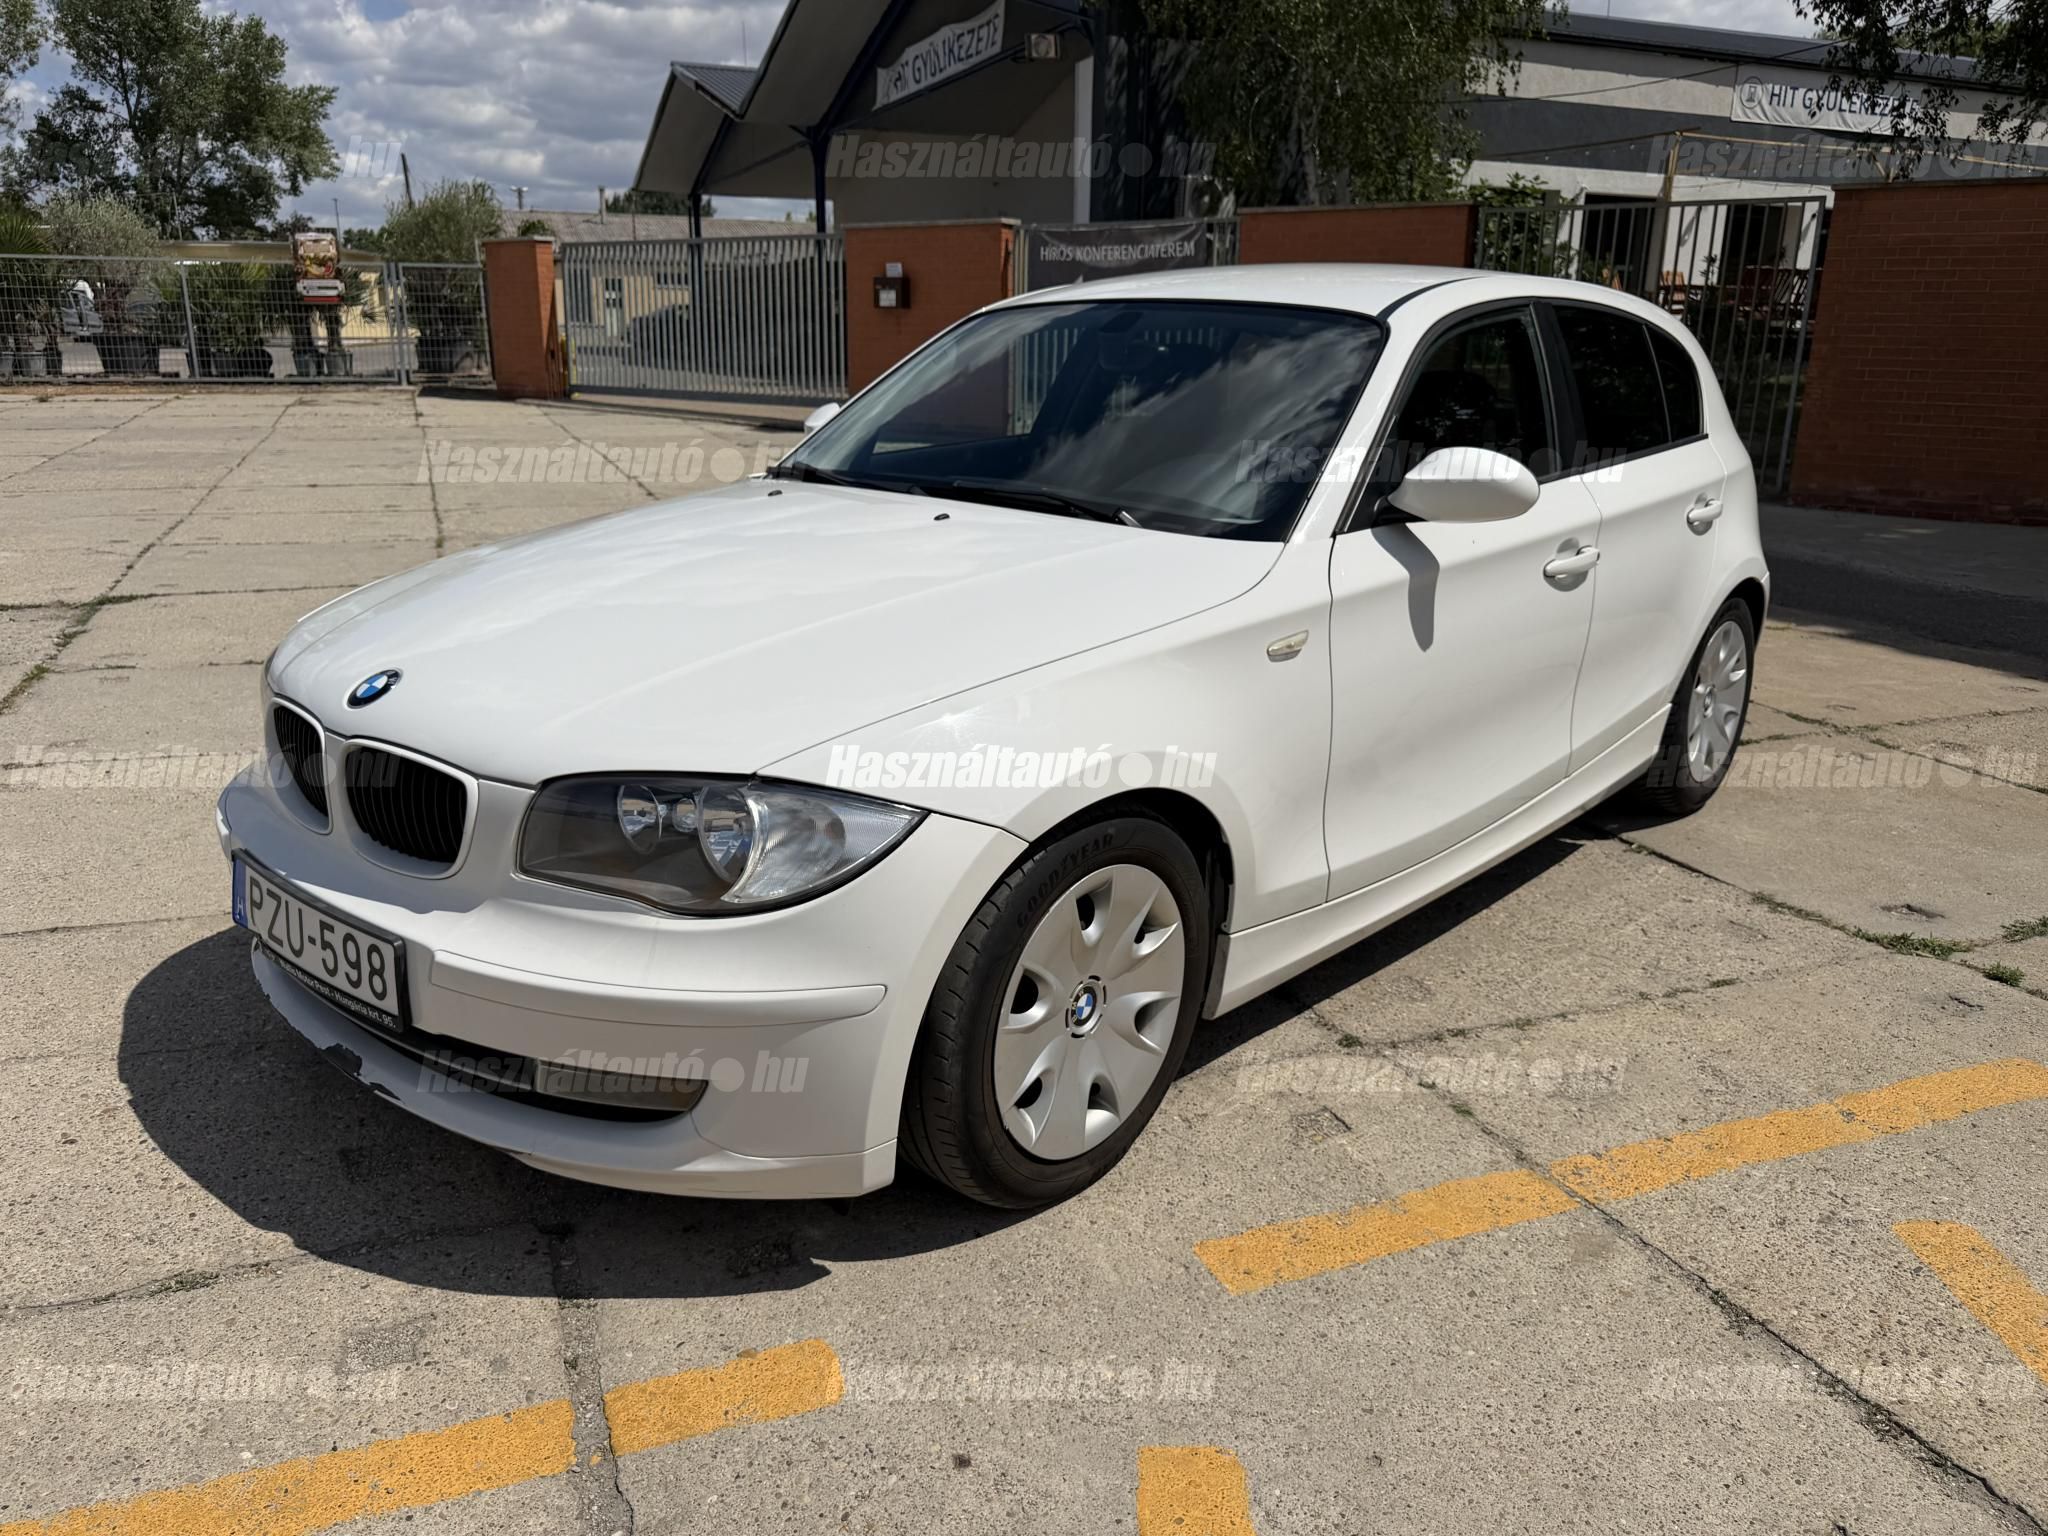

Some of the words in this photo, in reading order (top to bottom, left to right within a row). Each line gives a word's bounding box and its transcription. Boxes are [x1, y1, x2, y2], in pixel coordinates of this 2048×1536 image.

[1769, 84, 1799, 109] HIT
[1017, 832, 1115, 929] GOODYEAR
[249, 875, 388, 1001] PZU-598
